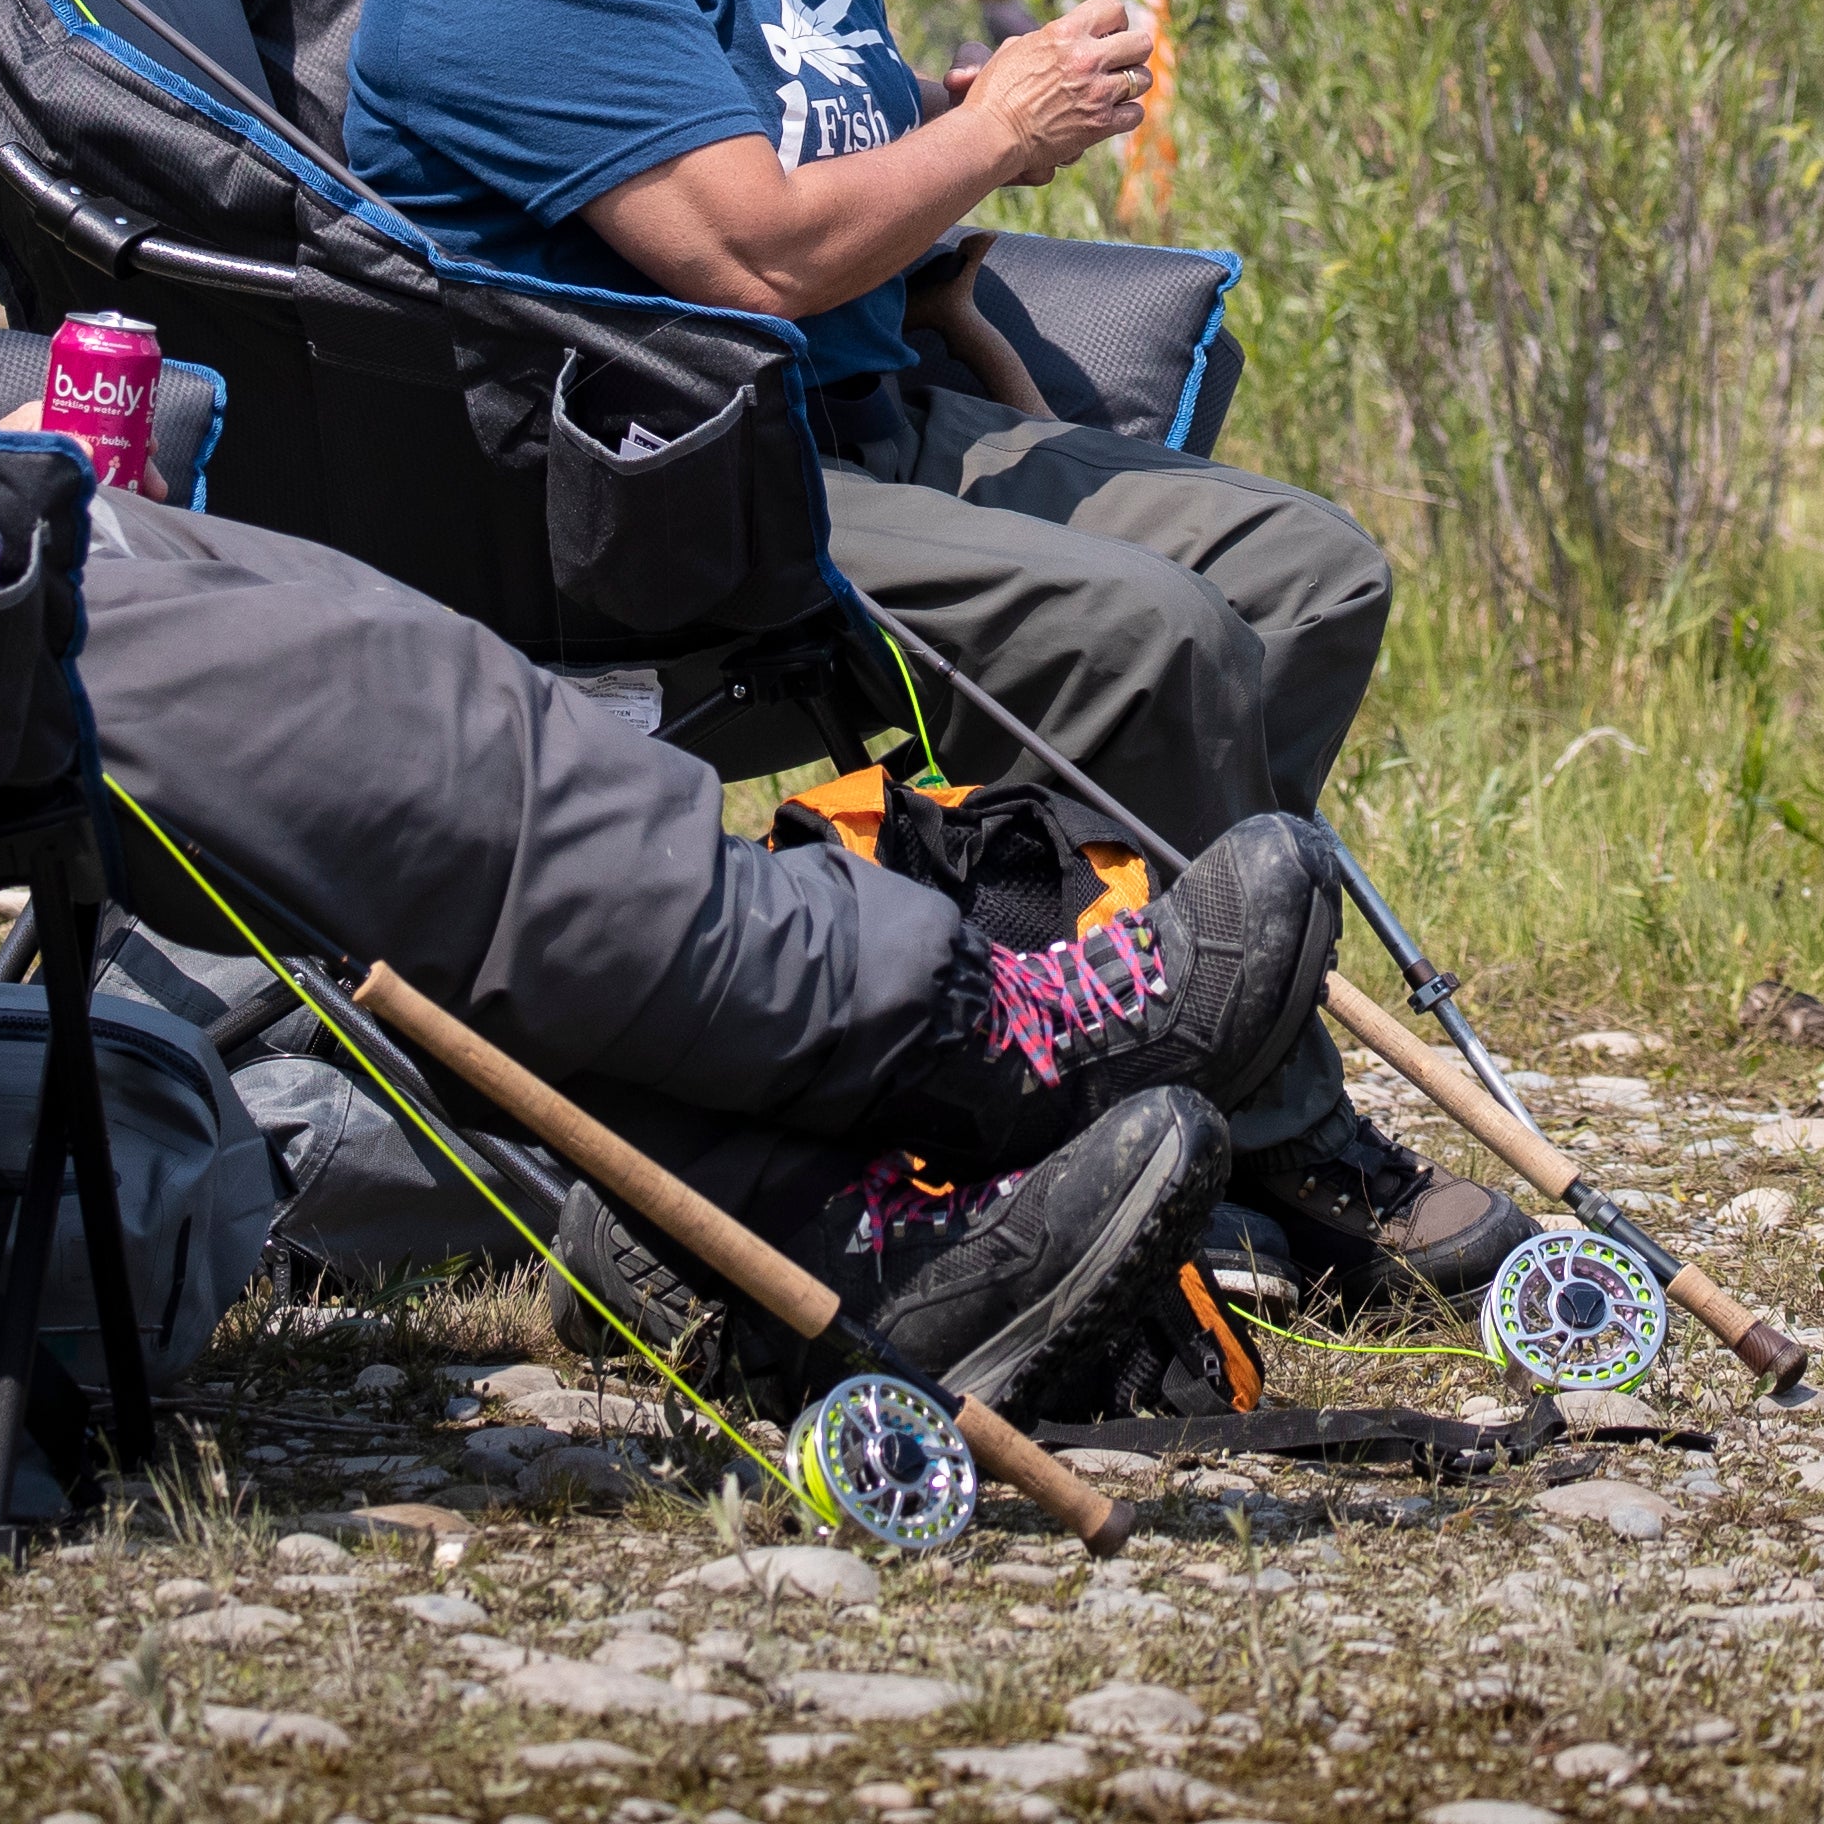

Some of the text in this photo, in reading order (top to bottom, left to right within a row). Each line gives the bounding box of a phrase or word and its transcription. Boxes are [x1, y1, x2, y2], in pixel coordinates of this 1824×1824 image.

[810, 93, 892, 157] Fish
[54, 363, 145, 417] bubly
[93, 406, 122, 416] water
